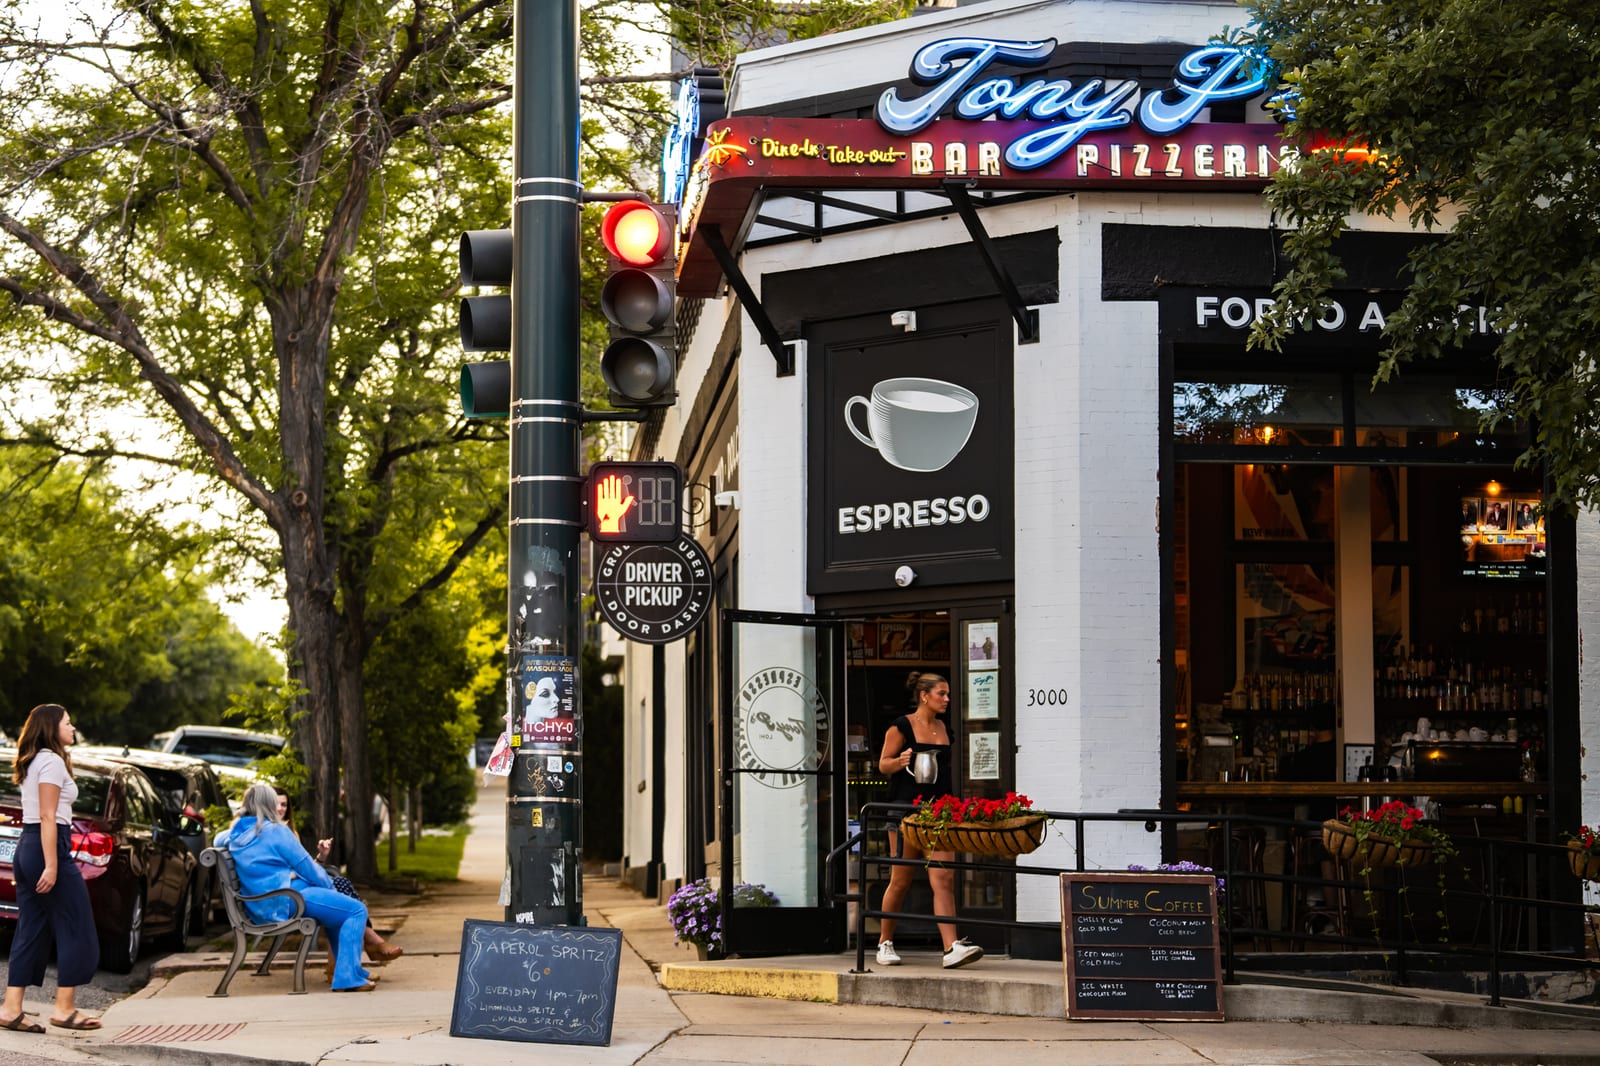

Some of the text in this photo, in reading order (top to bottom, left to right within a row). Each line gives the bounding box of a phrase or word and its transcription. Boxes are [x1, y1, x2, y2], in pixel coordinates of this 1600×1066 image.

[875, 37, 1138, 170] Tony
[762, 138, 905, 164] Dine-In Take-out
[911, 142, 1001, 175] BAR
[838, 494, 991, 535] ESPRESSO
[625, 562, 683, 583] DRIVER
[678, 541, 705, 578] UBER
[625, 586, 683, 606] PICKUP
[607, 600, 701, 634] DOOR DASH
[1027, 688, 1068, 707] 3000
[1149, 919, 1187, 927] COCONUT
[486, 941, 605, 962] APEROL SPRITZ
